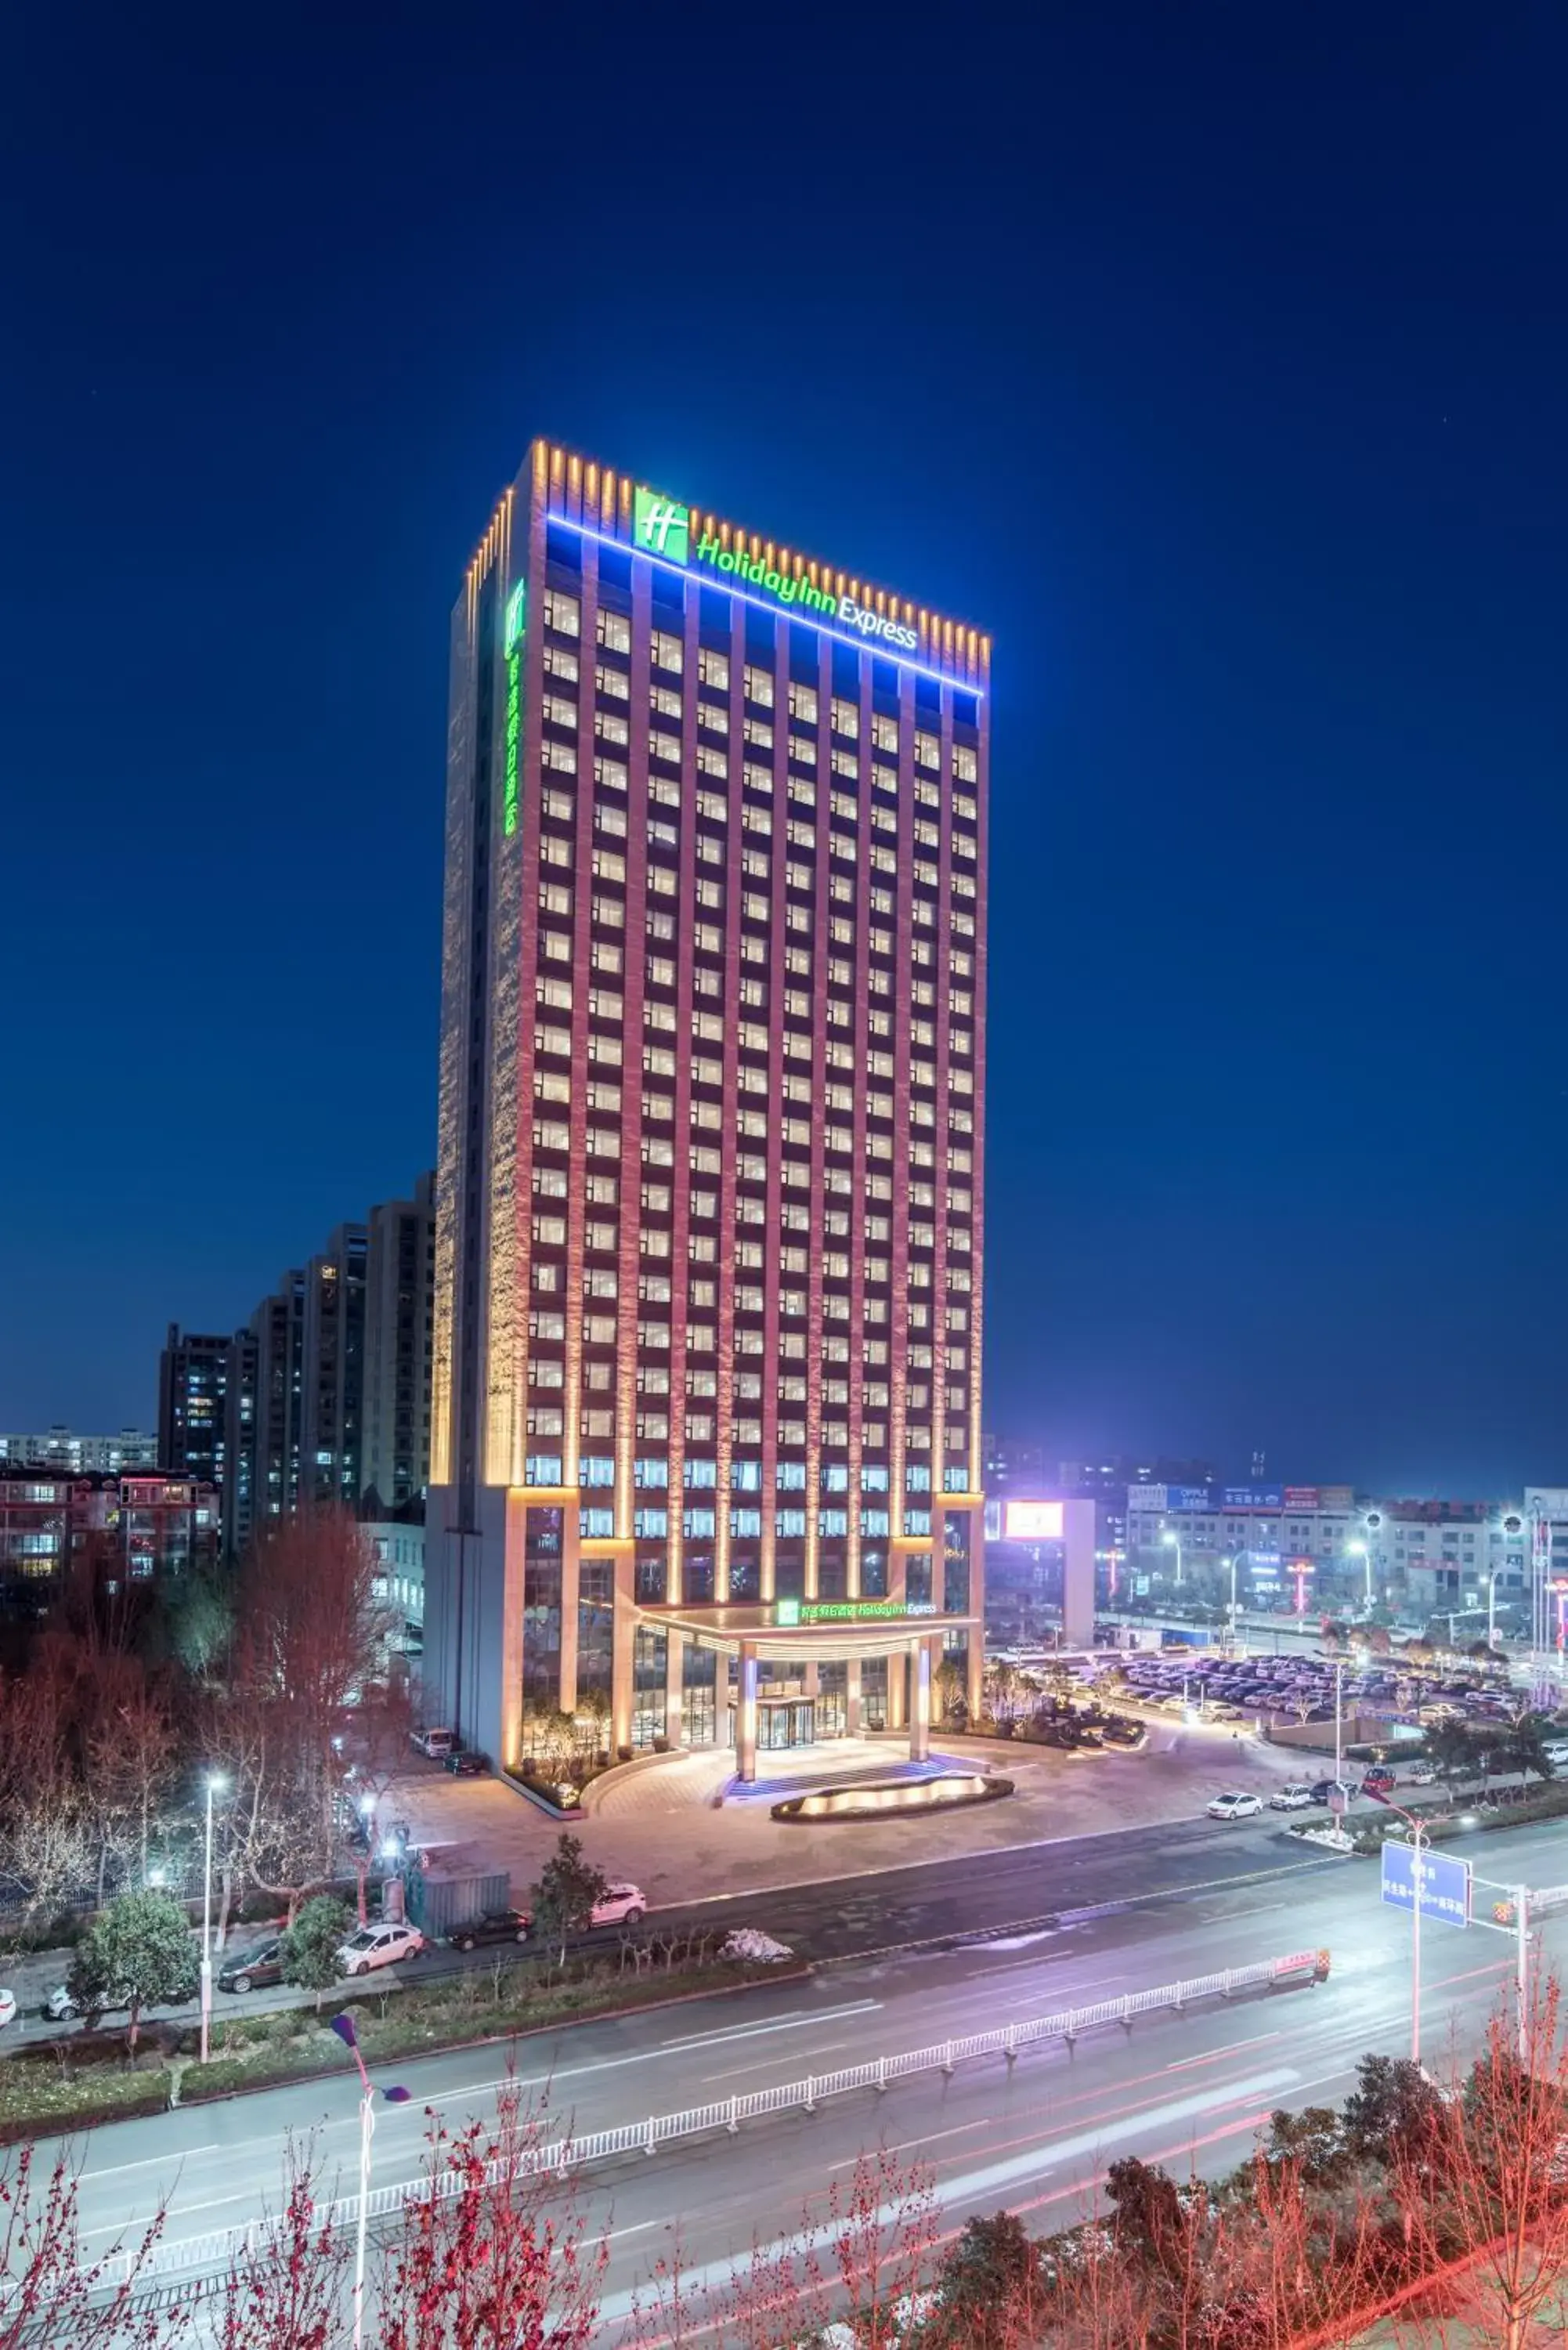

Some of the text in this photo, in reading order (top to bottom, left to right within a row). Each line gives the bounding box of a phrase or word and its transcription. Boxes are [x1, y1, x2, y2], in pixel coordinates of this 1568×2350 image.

[696, 533, 918, 650] Holiday Inn Express
